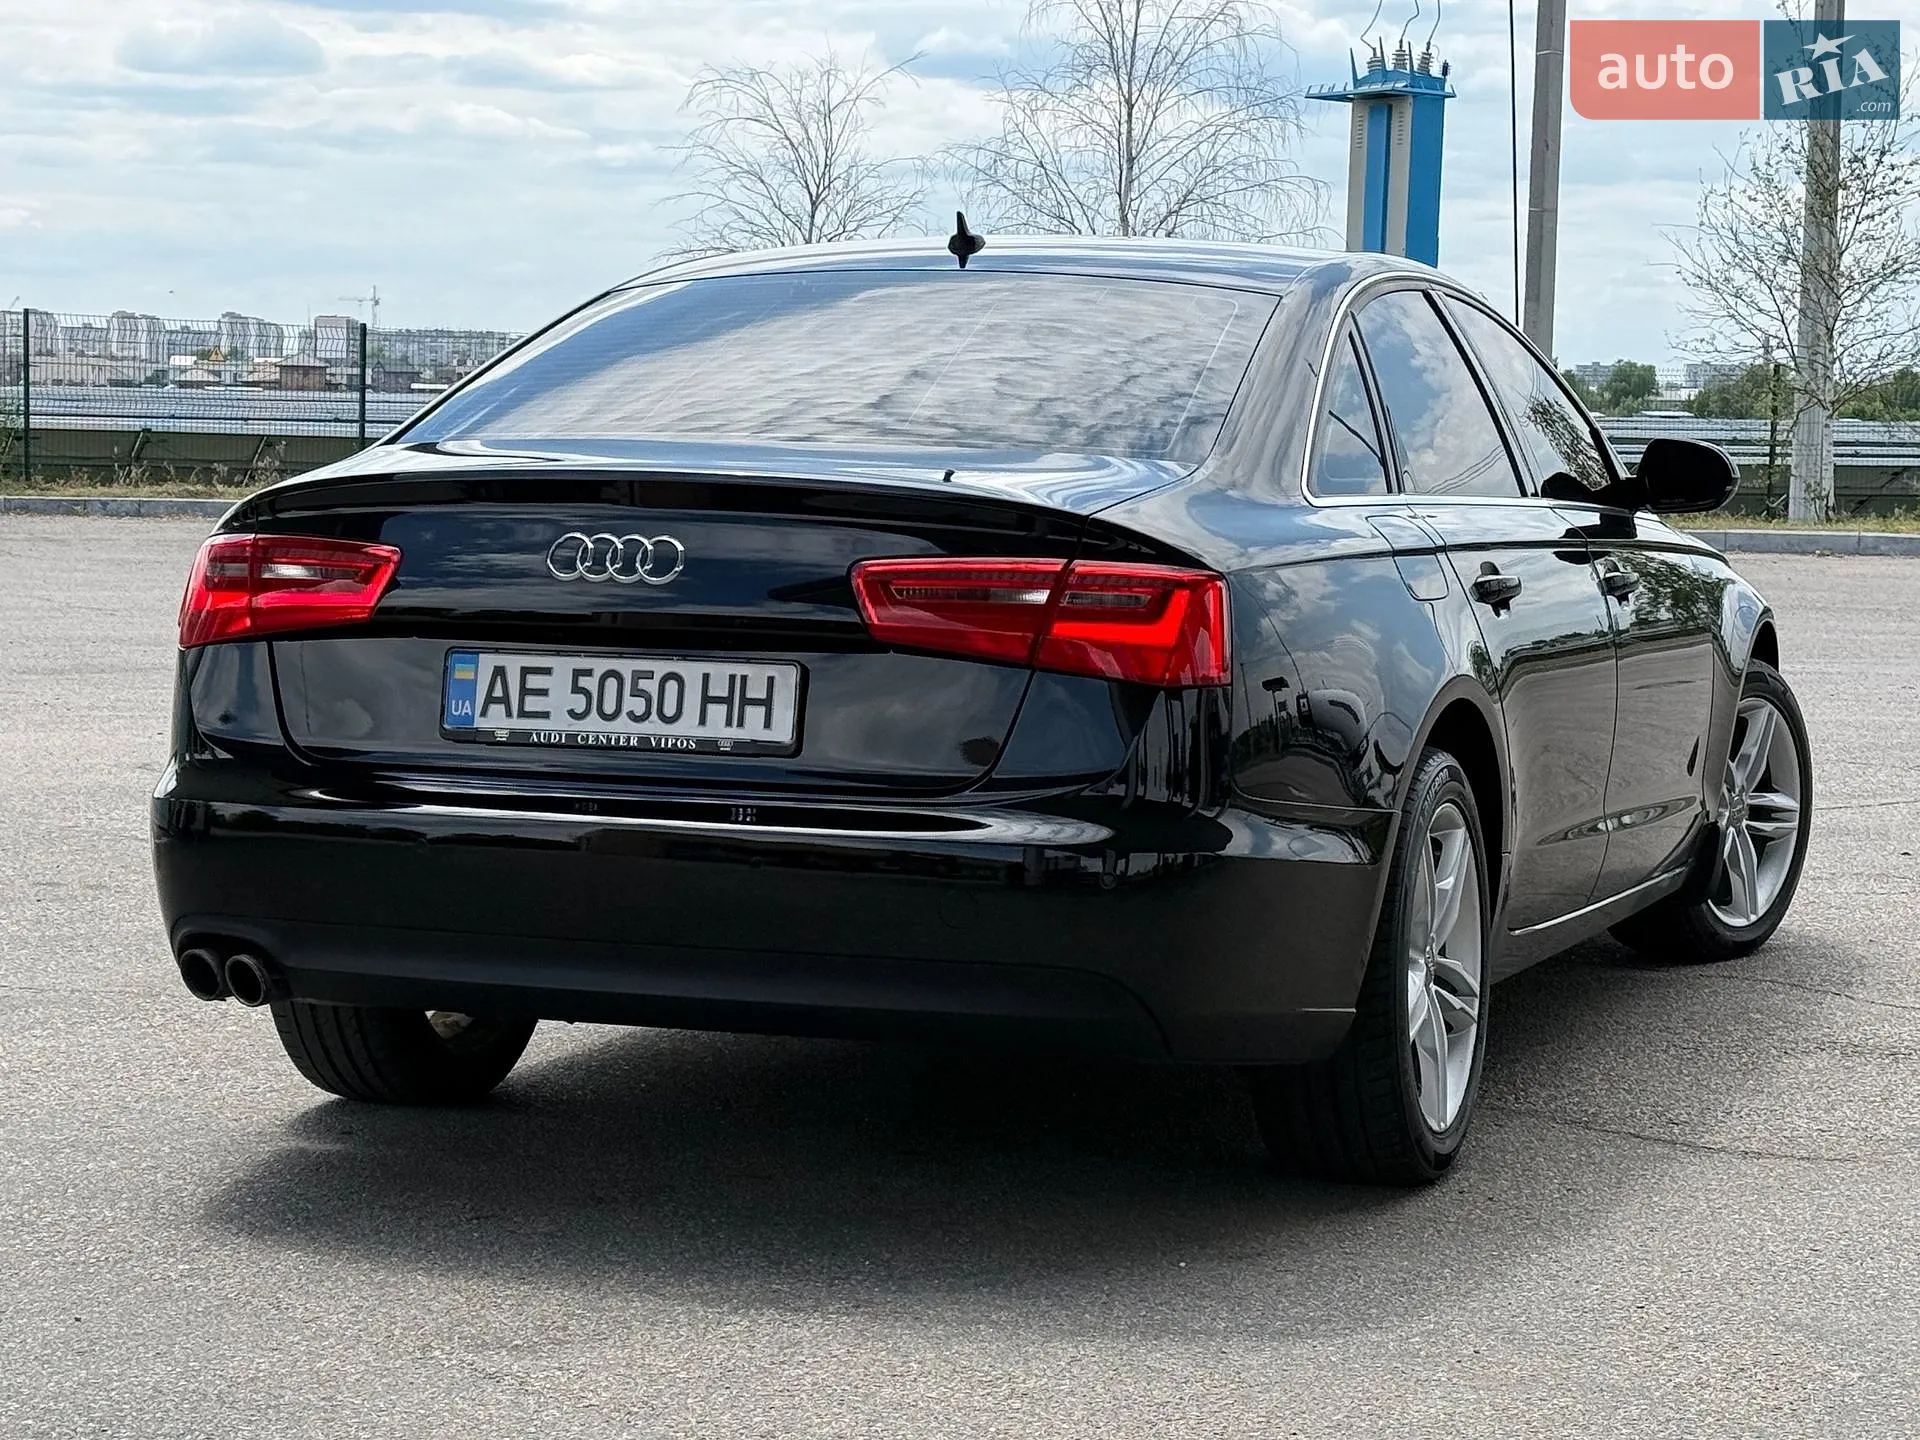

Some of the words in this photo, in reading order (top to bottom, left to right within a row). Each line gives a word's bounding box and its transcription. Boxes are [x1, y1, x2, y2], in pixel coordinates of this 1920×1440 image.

[479, 665, 553, 720] AE
[566, 668, 686, 724] 5050
[698, 672, 775, 730] HH
[451, 700, 472, 716] UA
[529, 731, 566, 744] AUDI
[577, 733, 638, 747] CENTER
[650, 736, 696, 750] VIPOS
